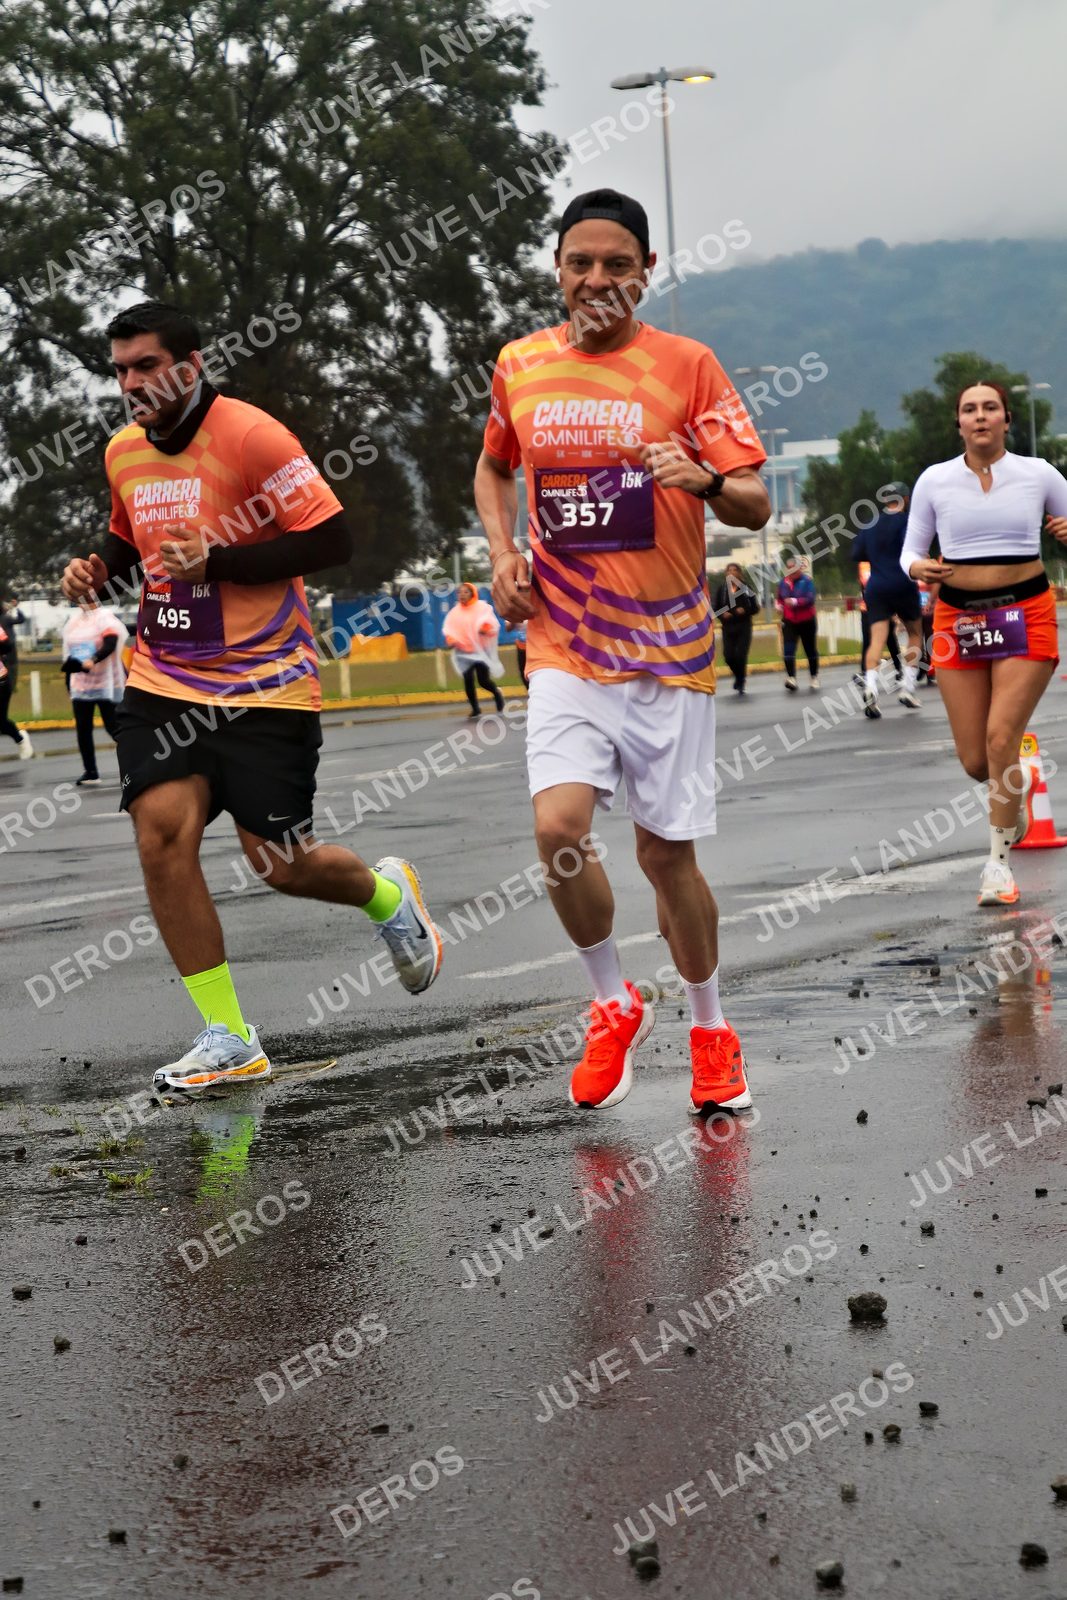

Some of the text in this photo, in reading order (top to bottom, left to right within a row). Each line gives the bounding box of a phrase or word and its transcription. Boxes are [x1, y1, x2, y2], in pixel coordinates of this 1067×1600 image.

[533, 399, 643, 429] CARRERA
[541, 474, 588, 487] CARRERA
[621, 472, 643, 488] 15K
[134, 477, 202, 508] CARRERA
[562, 502, 614, 527] 357
[157, 607, 191, 629] 495
[1005, 611, 1019, 622] 15K
[974, 629, 1004, 646] 134
